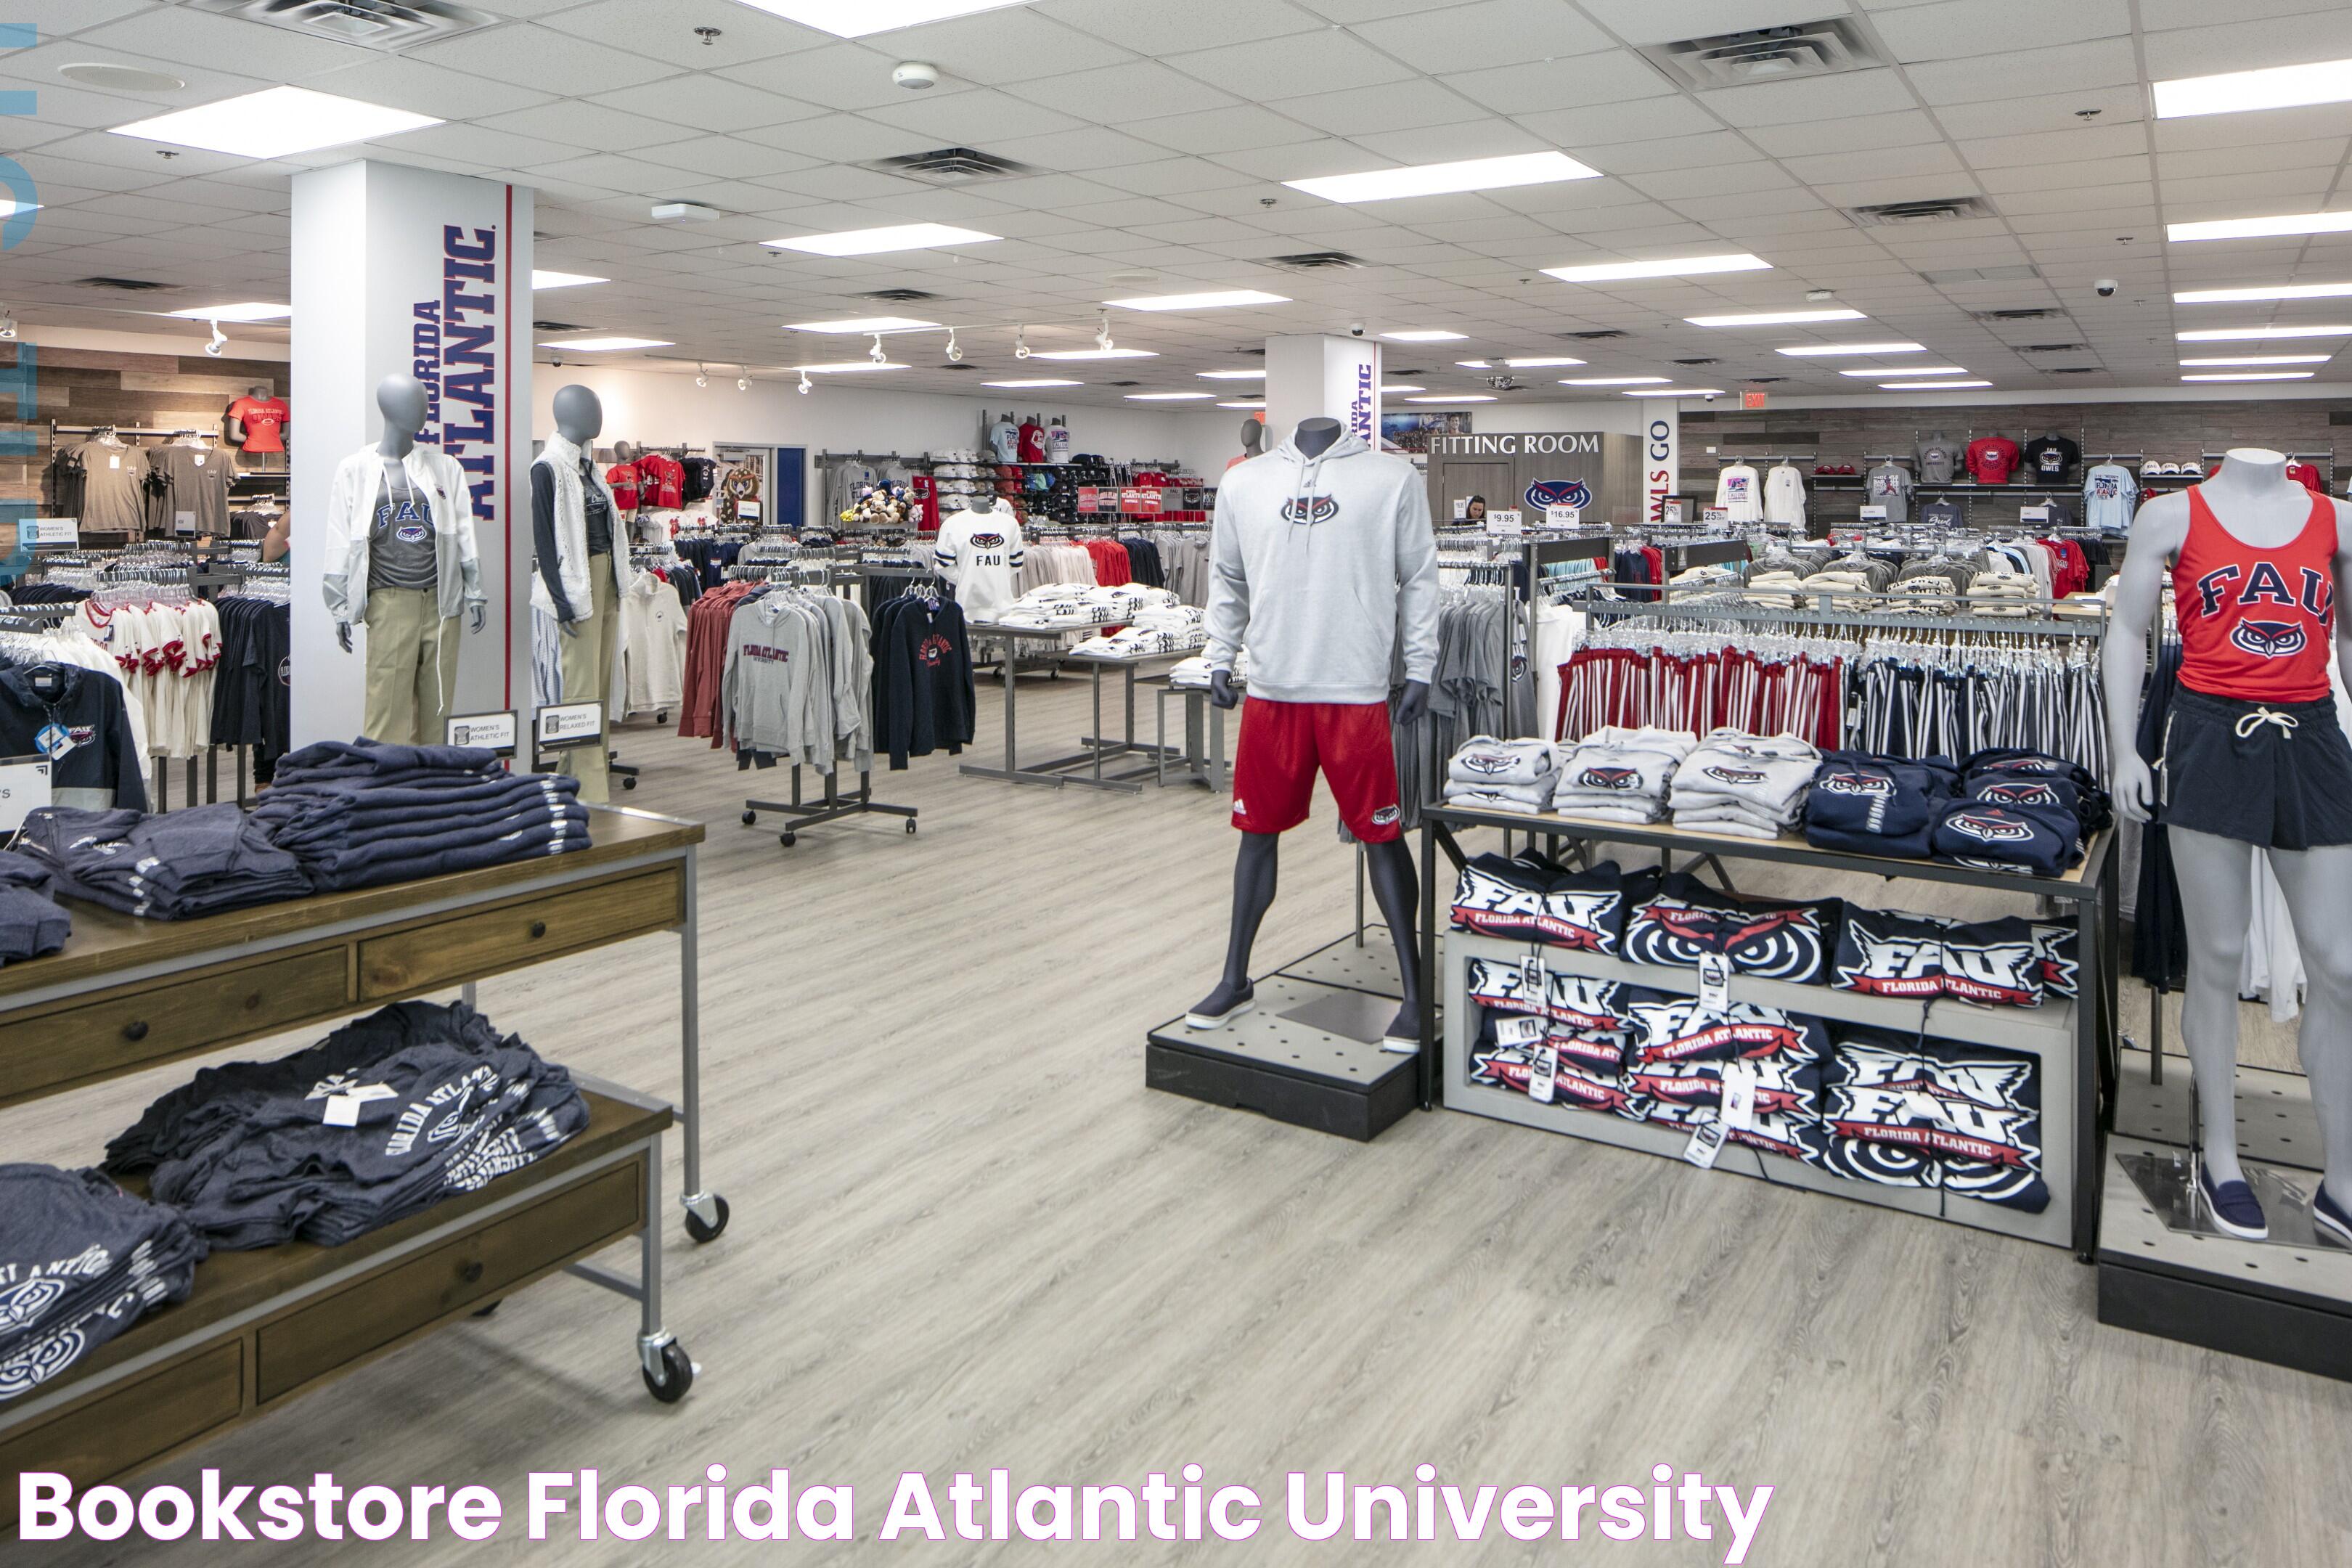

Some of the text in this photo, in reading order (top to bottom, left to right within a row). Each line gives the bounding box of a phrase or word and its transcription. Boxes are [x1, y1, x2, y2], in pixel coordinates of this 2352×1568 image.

[1745, 393, 1765, 408] EXIT
[1431, 434, 1600, 454] FITTING ROOM
[1649, 420, 1670, 462] GO
[1494, 514, 1514, 523] $9.95
[1551, 510, 1575, 519] $16.95
[976, 555, 1000, 566] FAU
[2196, 562, 2334, 627] FAU
[470, 724, 500, 733] WOMEN'S
[559, 721, 586, 730] RELAXED
[470, 732, 499, 741] ATHLETIC
[1461, 871, 1611, 928] FAU
[1475, 912, 1575, 939] FLORIDA ATLANTIC
[1858, 936, 2030, 989] FAU
[1882, 980, 1939, 993] FLORIDA
[1662, 1028, 1773, 1058] FLORIDA ATLANTIC
[1556, 1075, 1605, 1100] ATLANTIC
[1659, 1079, 1708, 1093] FLORIDA
[1863, 1127, 1922, 1143] FLORIDA
